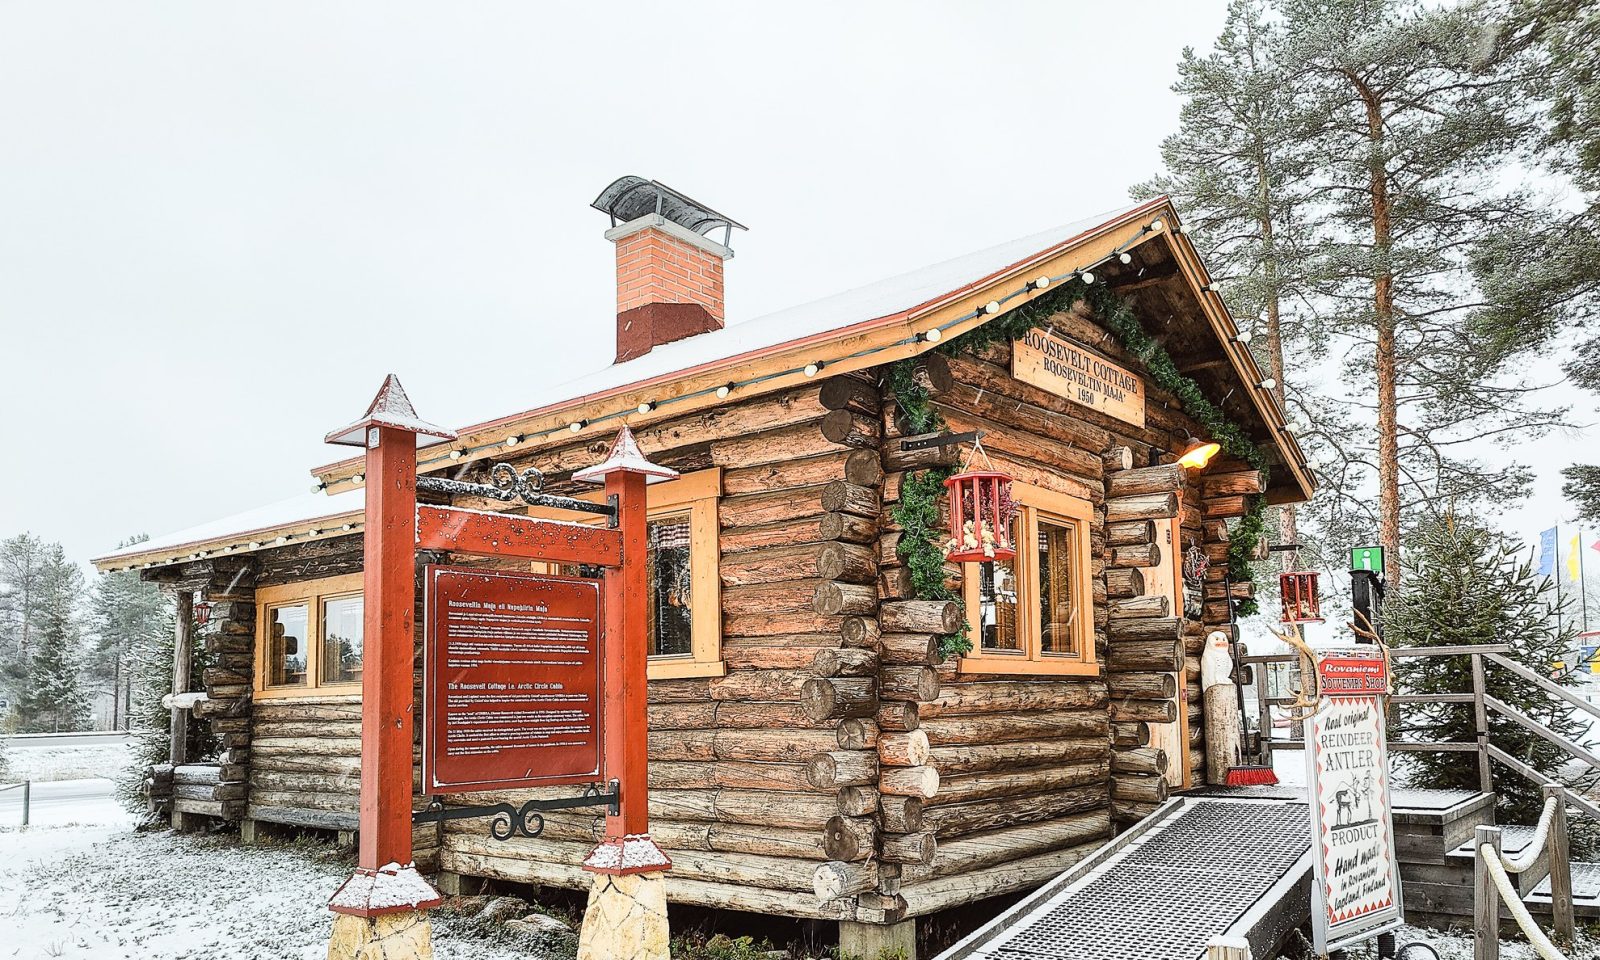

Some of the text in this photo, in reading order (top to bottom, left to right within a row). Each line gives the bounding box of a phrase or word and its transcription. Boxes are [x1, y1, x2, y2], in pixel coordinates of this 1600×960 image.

[1024, 330, 1138, 394] ROOSEVELT COTTAGE
[1043, 357, 1124, 403] ROOSEVELTIN MAJA
[1077, 388, 1095, 405] 1950
[1325, 664, 1380, 673] Rovaniemi
[487, 683, 507, 691] Cottage
[1321, 674, 1386, 689] SOUVENIRS SHOP
[1344, 706, 1370, 728] original
[1321, 732, 1374, 749] REINDEER
[1325, 749, 1375, 772] ANTLER
[1331, 824, 1378, 847] PRODUCT
[1335, 841, 1381, 878] Hand made
[1340, 864, 1379, 892] in Rovaniemi
